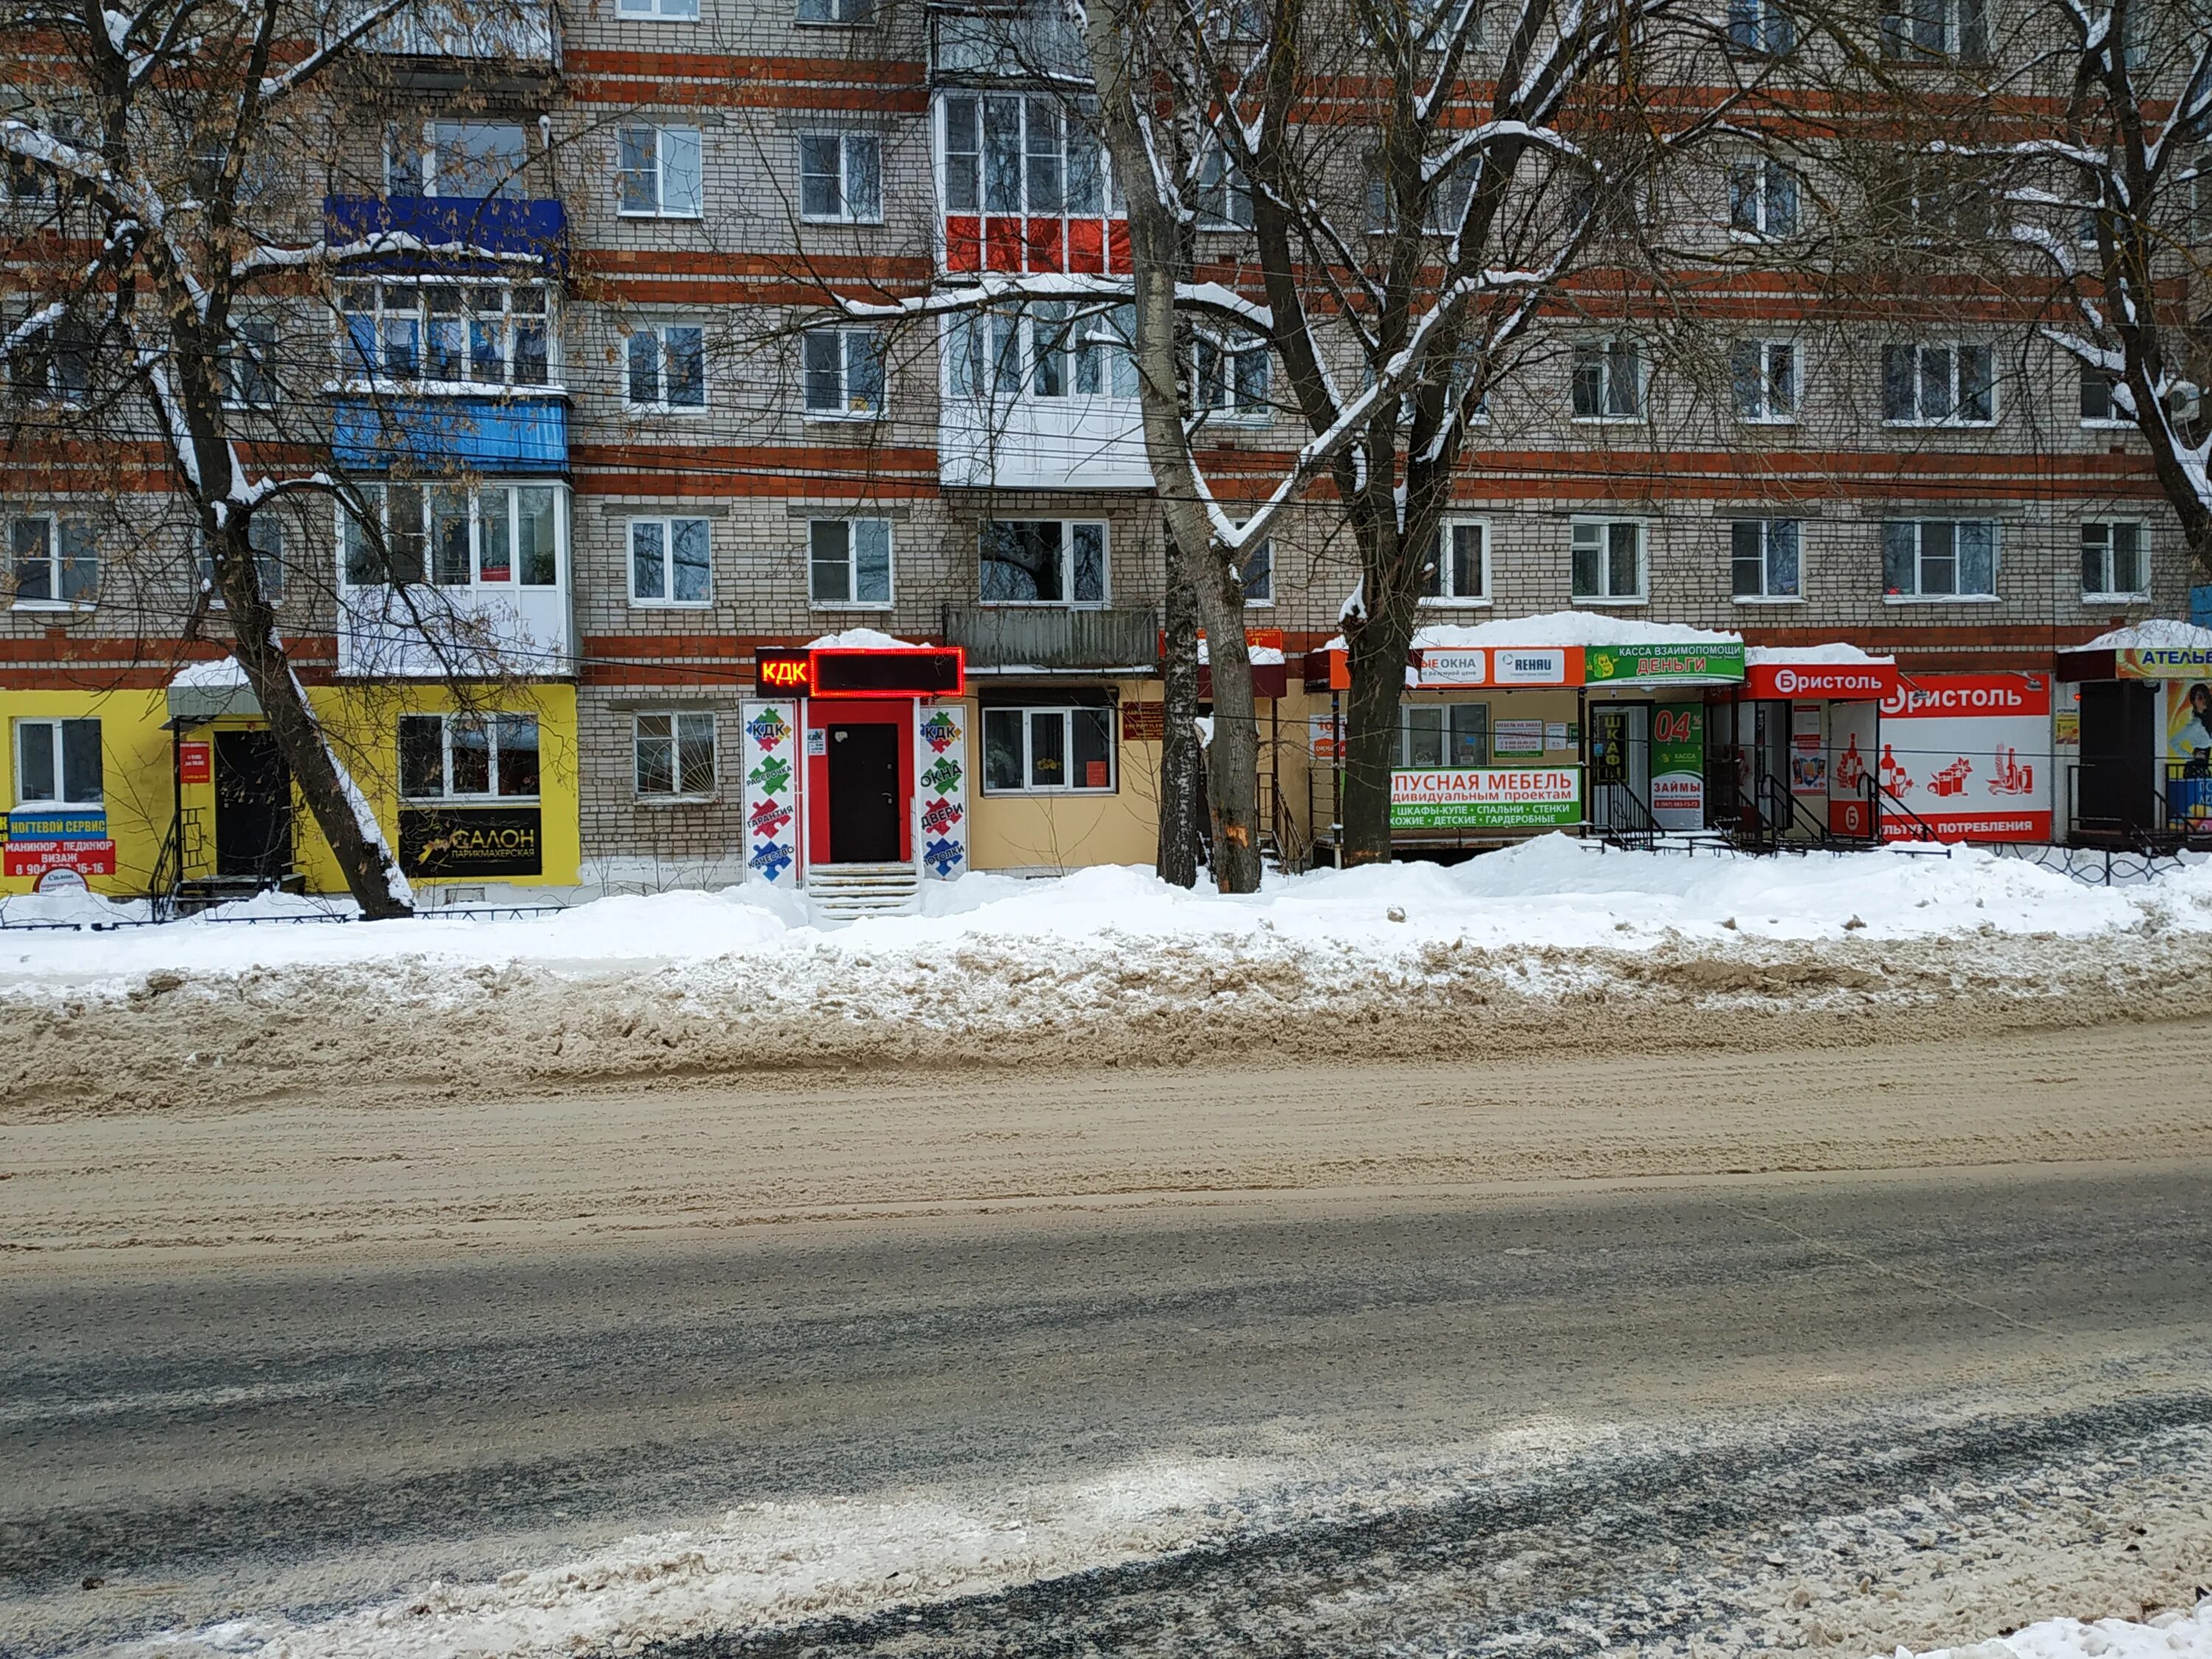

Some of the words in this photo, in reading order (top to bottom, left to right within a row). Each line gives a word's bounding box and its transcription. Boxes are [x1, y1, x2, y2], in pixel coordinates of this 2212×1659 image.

[1619, 647, 1652, 656] КАССА
[1655, 646, 1741, 655] ВЗАИМОПОМОЩИ
[1440, 658, 1476, 668] ОКНА
[1515, 659, 1551, 670] REHAU
[1636, 657, 1706, 675] ДЕНЬГИ
[762, 662, 807, 684] КДК
[1775, 669, 1882, 693] Бристоль
[753, 723, 785, 737] КДК
[925, 726, 955, 740] КДК
[746, 765, 793, 787] РАССРОЧКА
[921, 763, 962, 787] ОКНА
[1391, 775, 1480, 791] ПУСНАЯ
[1488, 773, 1572, 790] МЕБЕЛЬ
[1654, 781, 1700, 792] ЗАЙМЫ
[1504, 790, 1572, 802] проектам
[747, 805, 793, 828] ГАРАНТИЯ
[921, 802, 964, 830] ДВЕРИ
[1397, 805, 1467, 815] ШКАФЫ-КУПЕ
[1477, 805, 1523, 814] СПАЛЬНИ
[1532, 804, 1570, 813] СТЕНКИ
[11, 818, 63, 834] НОГТЕВОЙ
[66, 819, 105, 832] СЕРВИС
[1433, 815, 1476, 825] ДЕТСКИЕ
[1486, 814, 1556, 824] ГАРДЕРОБНЫЕ
[1882, 824, 1933, 835] ЛЬТУРА
[1938, 821, 2033, 834] ПОТРЕБЛЕНИЯ
[451, 829, 535, 849] САЛОН
[63, 841, 113, 852] ПЕДИКЮР
[452, 848, 535, 858] ПАРИКМАХЕРСКАЯ
[41, 853, 78, 863] ВИЗАЖ
[748, 846, 794, 871] КАЧЕСТВО
[923, 845, 964, 868] ПОТОЛКИ
[15, 864, 22, 875] 8
